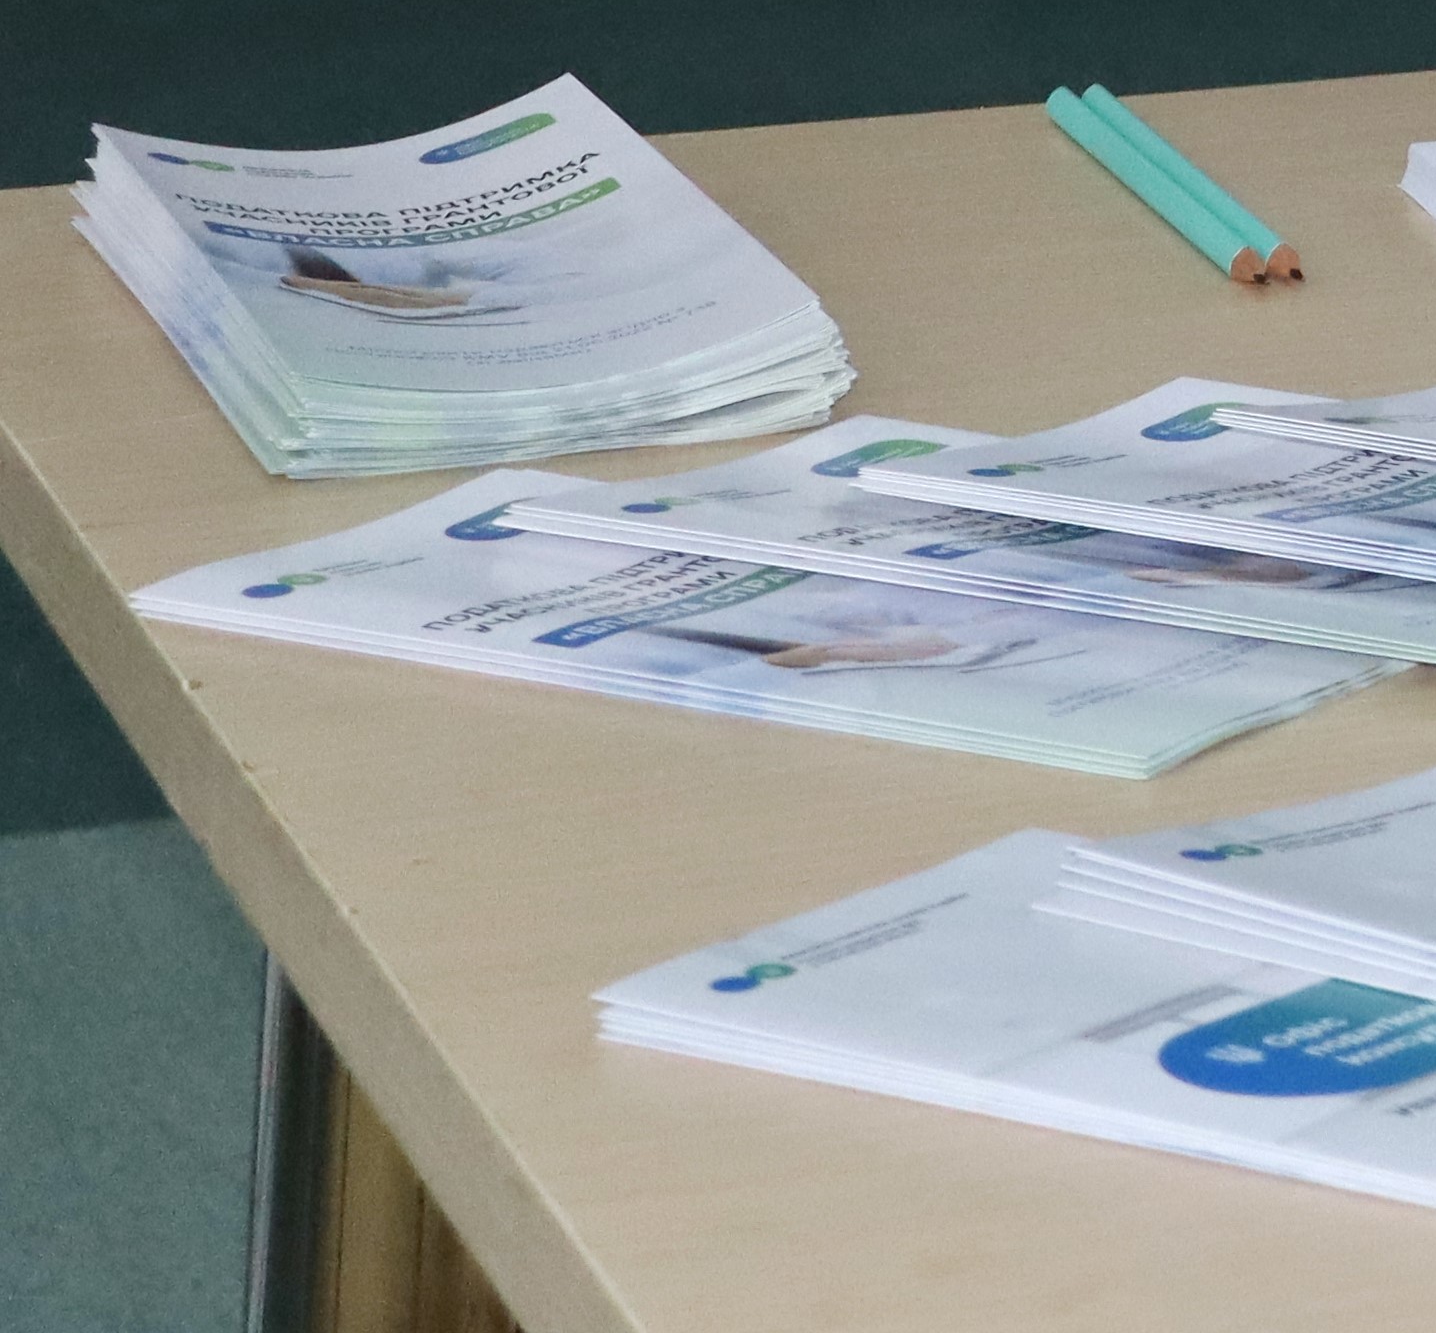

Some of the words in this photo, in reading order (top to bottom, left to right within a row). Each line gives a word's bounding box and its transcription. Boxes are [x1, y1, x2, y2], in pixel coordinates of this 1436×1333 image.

[176, 193, 387, 219] ПОДАТКОВА
[399, 152, 600, 216] ПІДТРИМКА
[404, 165, 590, 225] ГРАНТОВОЇ
[310, 211, 502, 235] ПРОГРАМИ
[1290, 449, 1381, 481] ПІДТРИ
[1326, 454, 1417, 487] ГРАНТО
[421, 584, 590, 631] ПОДАТКОВА
[589, 551, 690, 585] ПІДТРИ
[624, 554, 725, 591] ГРАНТО
